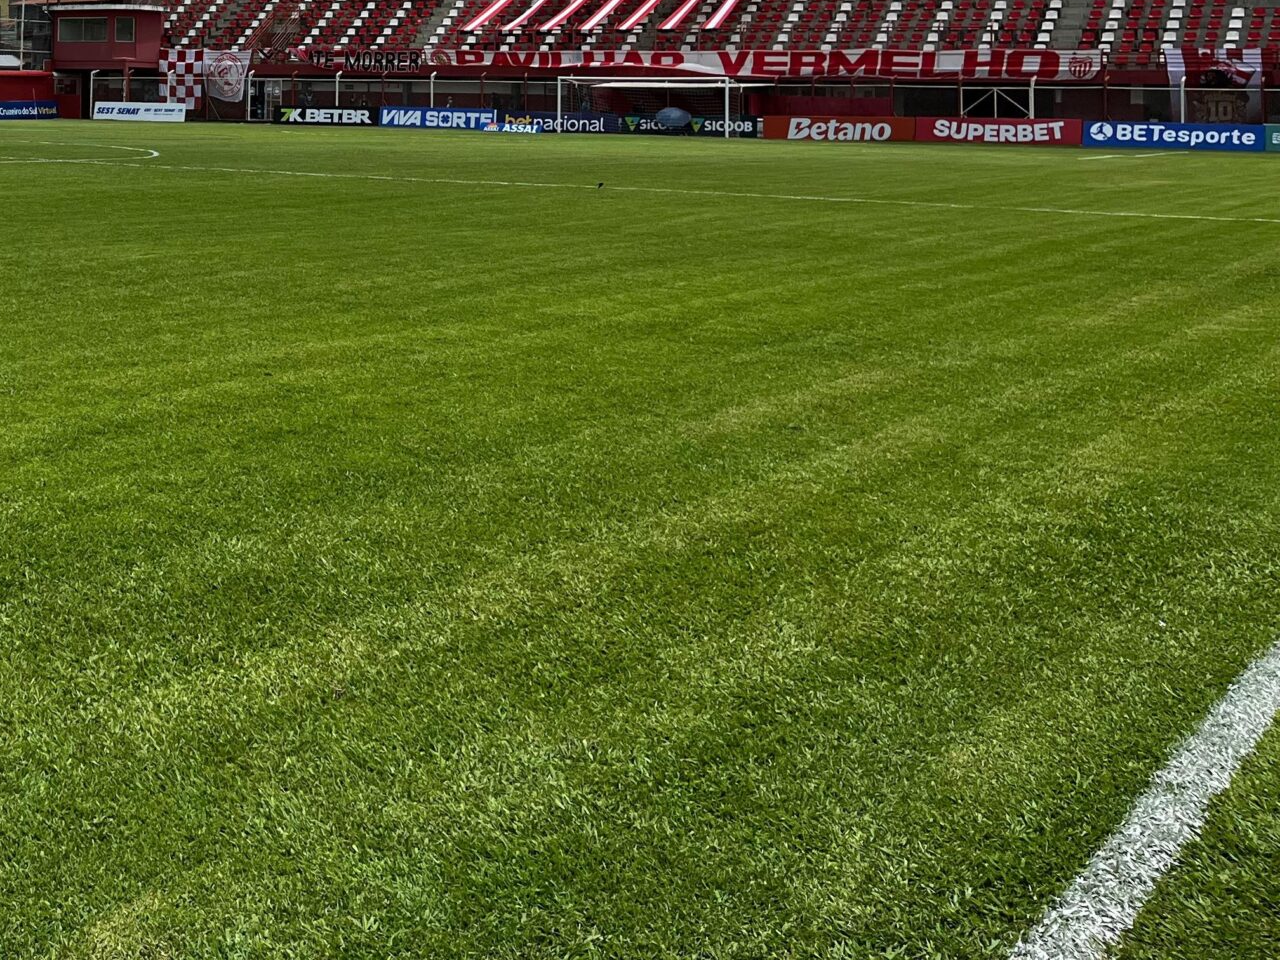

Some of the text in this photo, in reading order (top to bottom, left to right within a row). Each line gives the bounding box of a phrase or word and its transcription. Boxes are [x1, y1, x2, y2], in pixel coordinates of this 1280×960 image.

[343, 49, 421, 73] MORRER
[717, 49, 1061, 78] VERMELHO
[0, 106, 57, 115] Cruzeiro do Sul Virtual
[96, 106, 115, 115] SEST
[116, 107, 141, 115] SENAT
[280, 108, 373, 124] 7K.BET.BR
[381, 109, 493, 128] VIVA SORTE
[704, 120, 753, 132] SICOOB
[787, 118, 892, 141] Betano
[933, 119, 1065, 142] SUPERBET
[1116, 124, 1256, 146] BETesporte
